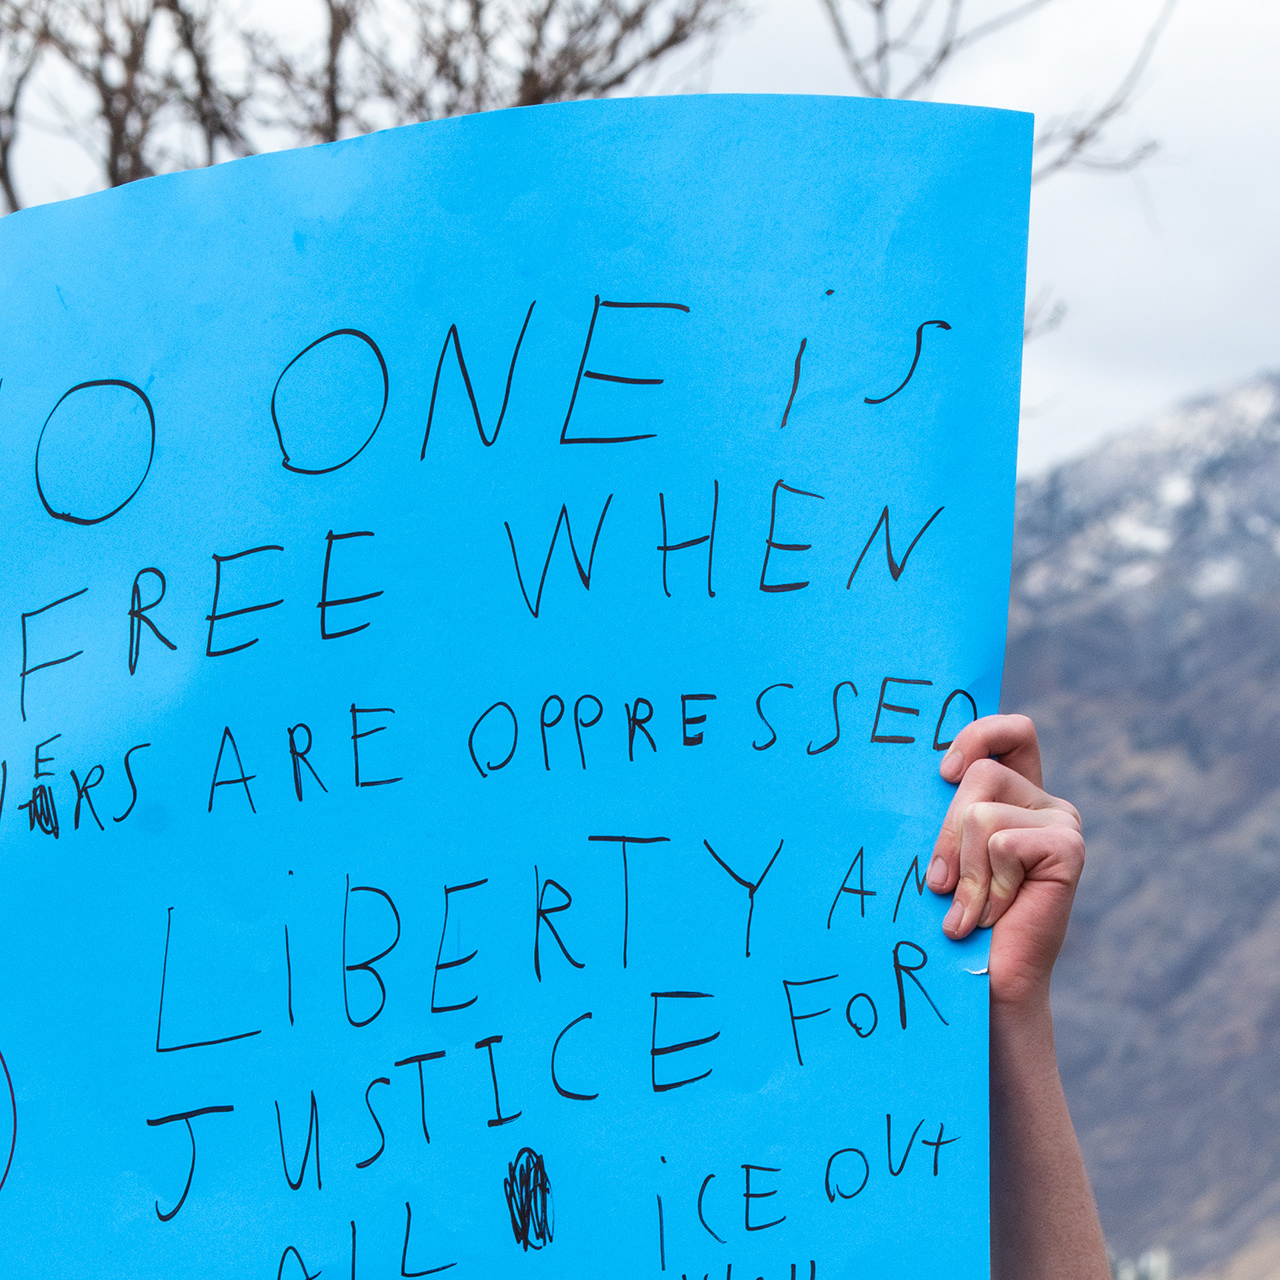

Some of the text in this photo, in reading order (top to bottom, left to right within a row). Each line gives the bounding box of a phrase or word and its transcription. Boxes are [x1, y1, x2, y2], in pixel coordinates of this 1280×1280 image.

[271, 294, 691, 475] ONE
[20, 478, 945, 722] FREE WHEN
[208, 703, 403, 813] ARE
[468, 676, 979, 778] OPPRESSED
[146, 939, 949, 1221] JUSTICE FOR
